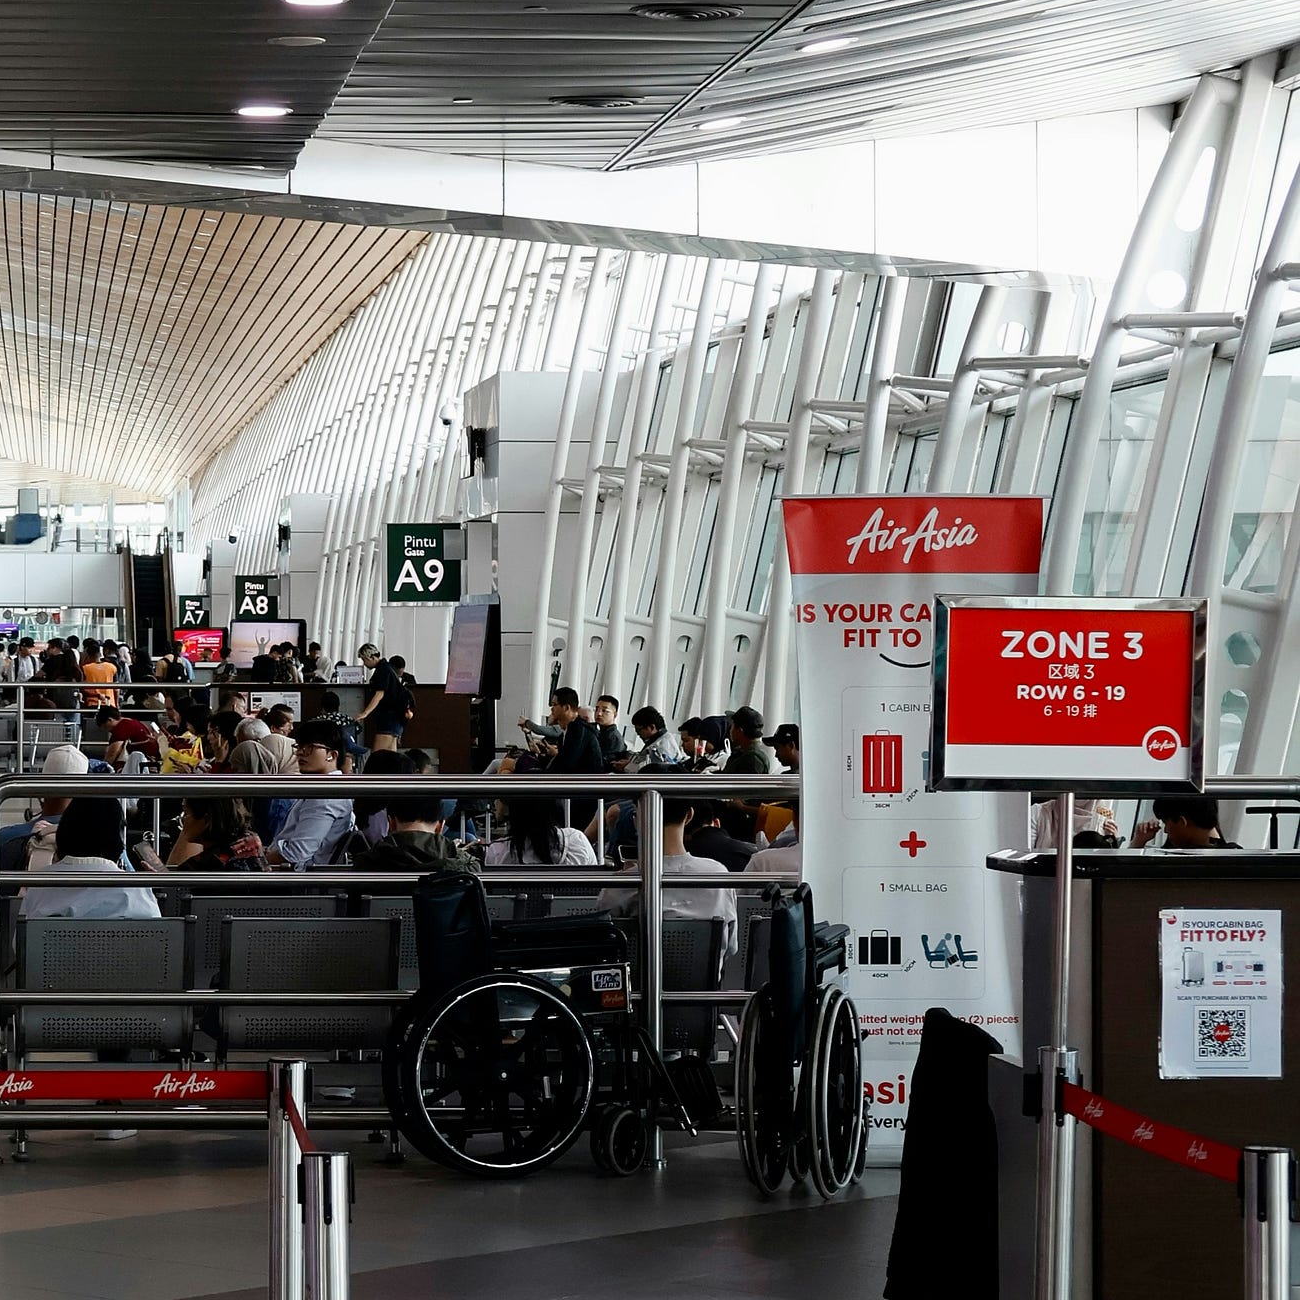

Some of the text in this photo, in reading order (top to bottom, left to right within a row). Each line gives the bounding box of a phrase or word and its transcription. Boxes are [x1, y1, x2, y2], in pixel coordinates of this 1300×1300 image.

[404, 535, 436, 548] Pintu
[404, 547, 425, 557] Gate
[393, 559, 444, 592] A9
[244, 581, 264, 590] Pintu
[239, 595, 269, 615] A8
[183, 610, 204, 624] A7
[797, 603, 932, 623] IS YOUR CA
[843, 628, 922, 648] FIT TO
[1001, 630, 1144, 660] ZONE 3
[1048, 663, 1095, 680] 区域 3
[1016, 684, 1068, 700] ROW
[1073, 685, 1086, 701] 6
[1105, 685, 1126, 701] 19
[880, 703, 886, 712] 1
[888, 703, 921, 712] CABIN
[1043, 705, 1053, 717] 6
[1066, 705, 1080, 717] 19
[1083, 704, 1098, 718] 排
[880, 883, 948, 893] 1 SMALL BAG
[1182, 921, 1191, 929] IS
[1191, 921, 1216, 929] YOUR
[1216, 921, 1244, 929] CABIN
[1245, 921, 1264, 929] BAG
[1180, 929, 1204, 942] FIT
[1206, 929, 1228, 942] TO
[859, 1015, 888, 1024] itted
[969, 1015, 984, 1025] (2)
[987, 1015, 1020, 1025] pieces
[864, 1028, 884, 1036] ust
[887, 1028, 905, 1036] not
[867, 1115, 906, 1131] Every
